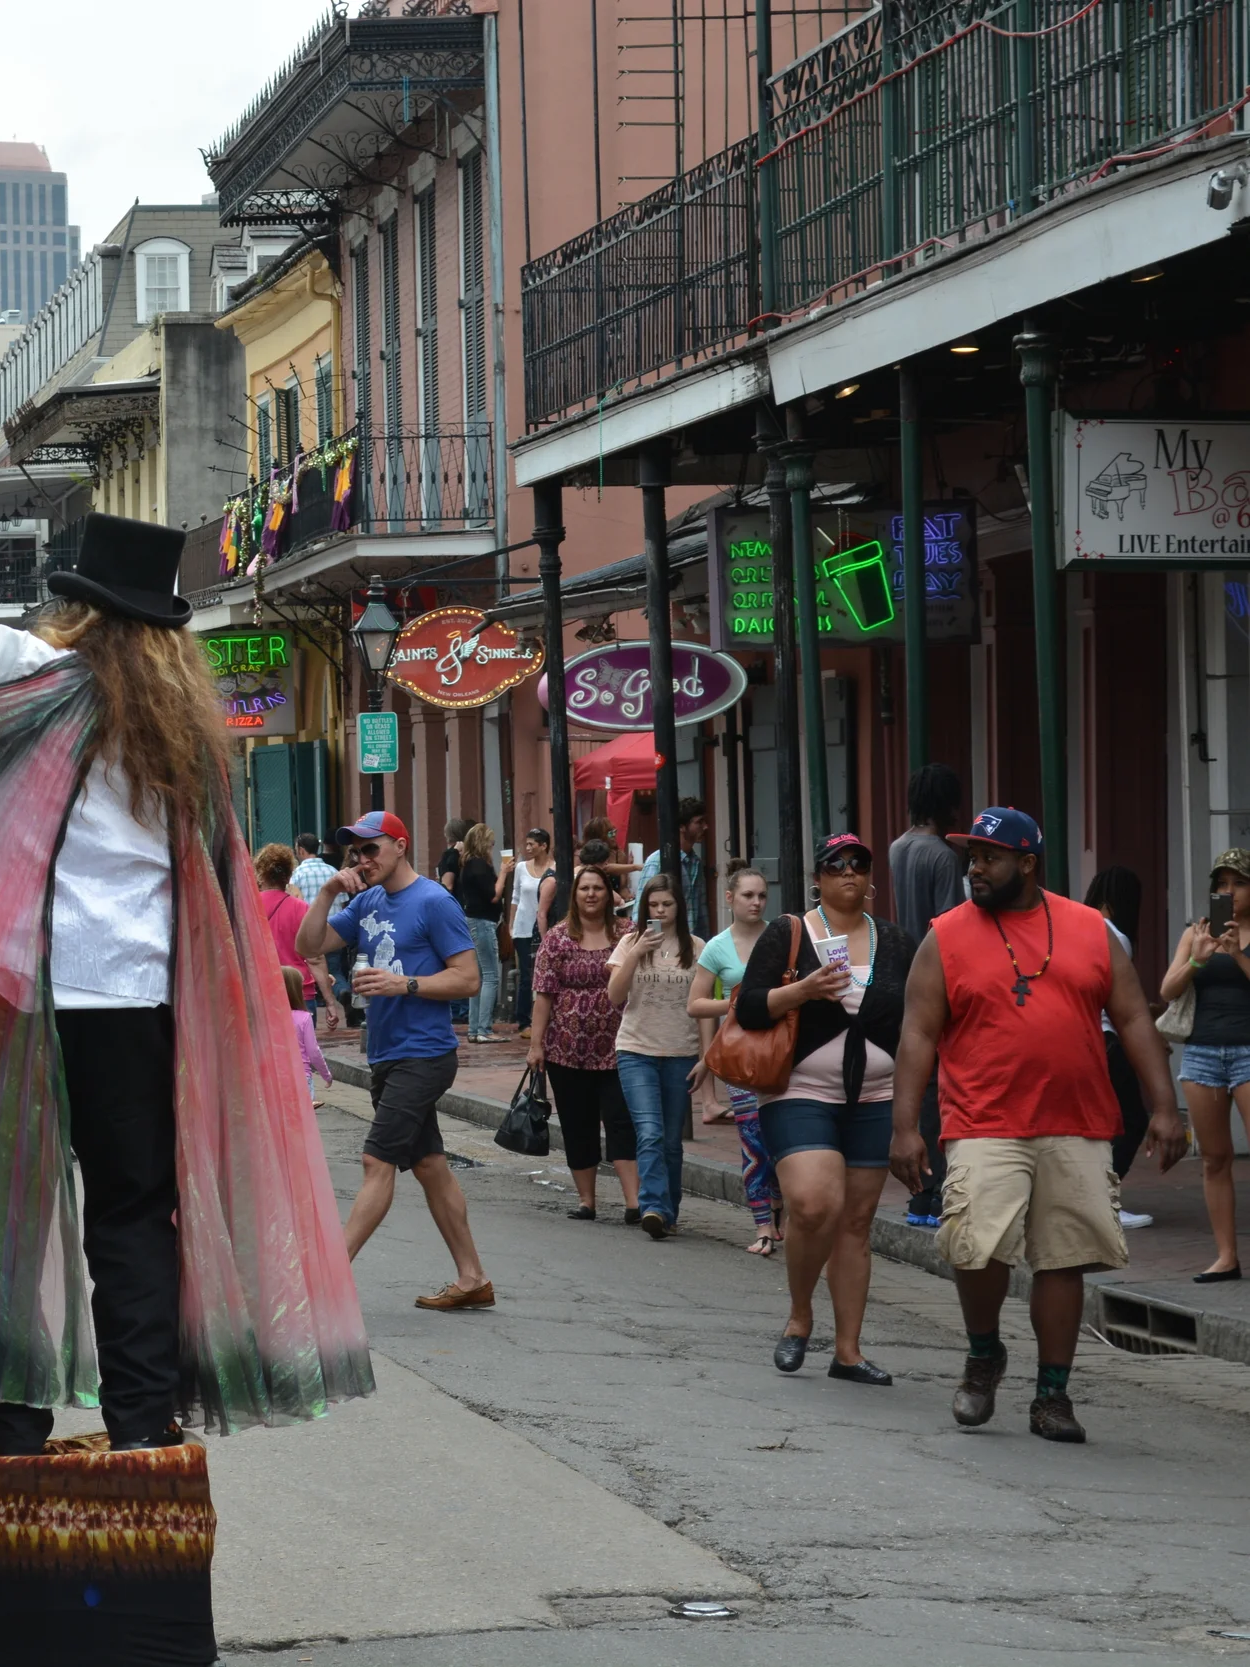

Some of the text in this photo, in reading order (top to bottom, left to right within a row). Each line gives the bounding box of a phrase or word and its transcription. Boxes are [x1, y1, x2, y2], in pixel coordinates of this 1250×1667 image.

[1153, 428, 1213, 481] My
[1118, 534, 1160, 554] LIVE
[196, 636, 286, 666] STER
[476, 645, 534, 665] SINNES
[231, 664, 262, 673] GRAS
[437, 689, 480, 697] NEW ORLEANS
[569, 667, 615, 708] So
[636, 973, 690, 984] FOR LOV
